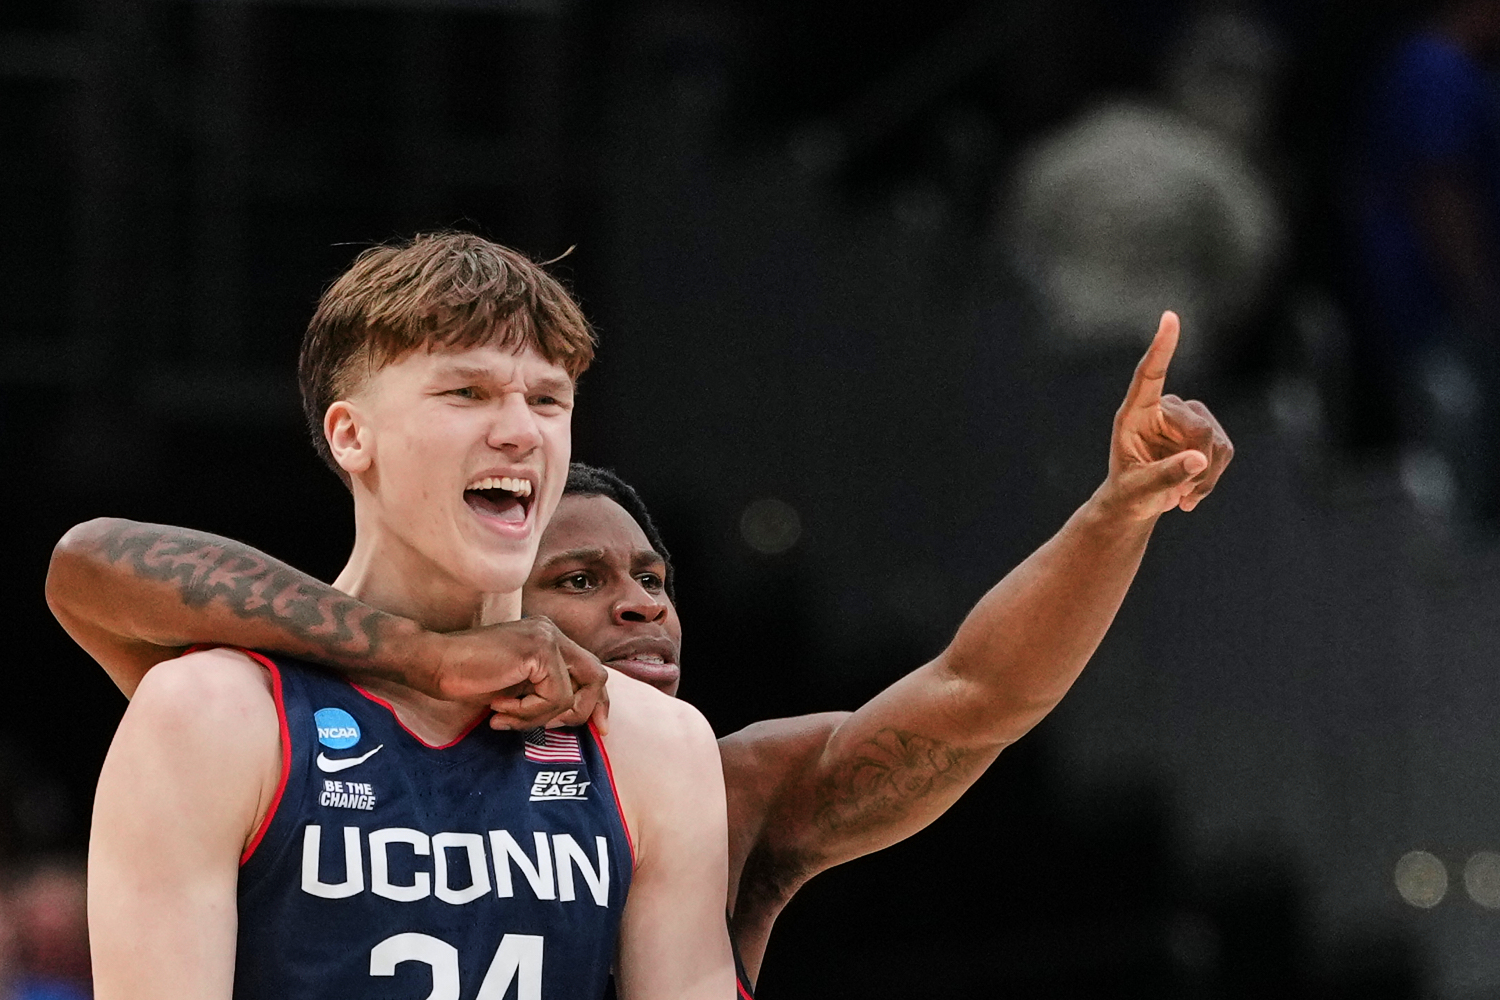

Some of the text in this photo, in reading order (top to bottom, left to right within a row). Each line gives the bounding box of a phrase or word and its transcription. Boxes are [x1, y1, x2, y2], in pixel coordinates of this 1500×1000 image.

[318, 727, 358, 739] NCAA
[534, 770, 579, 785] BIG
[323, 780, 373, 796] BE THE
[530, 781, 592, 797] EAST
[320, 791, 376, 811] CHANGE
[301, 825, 610, 909] UCONN
